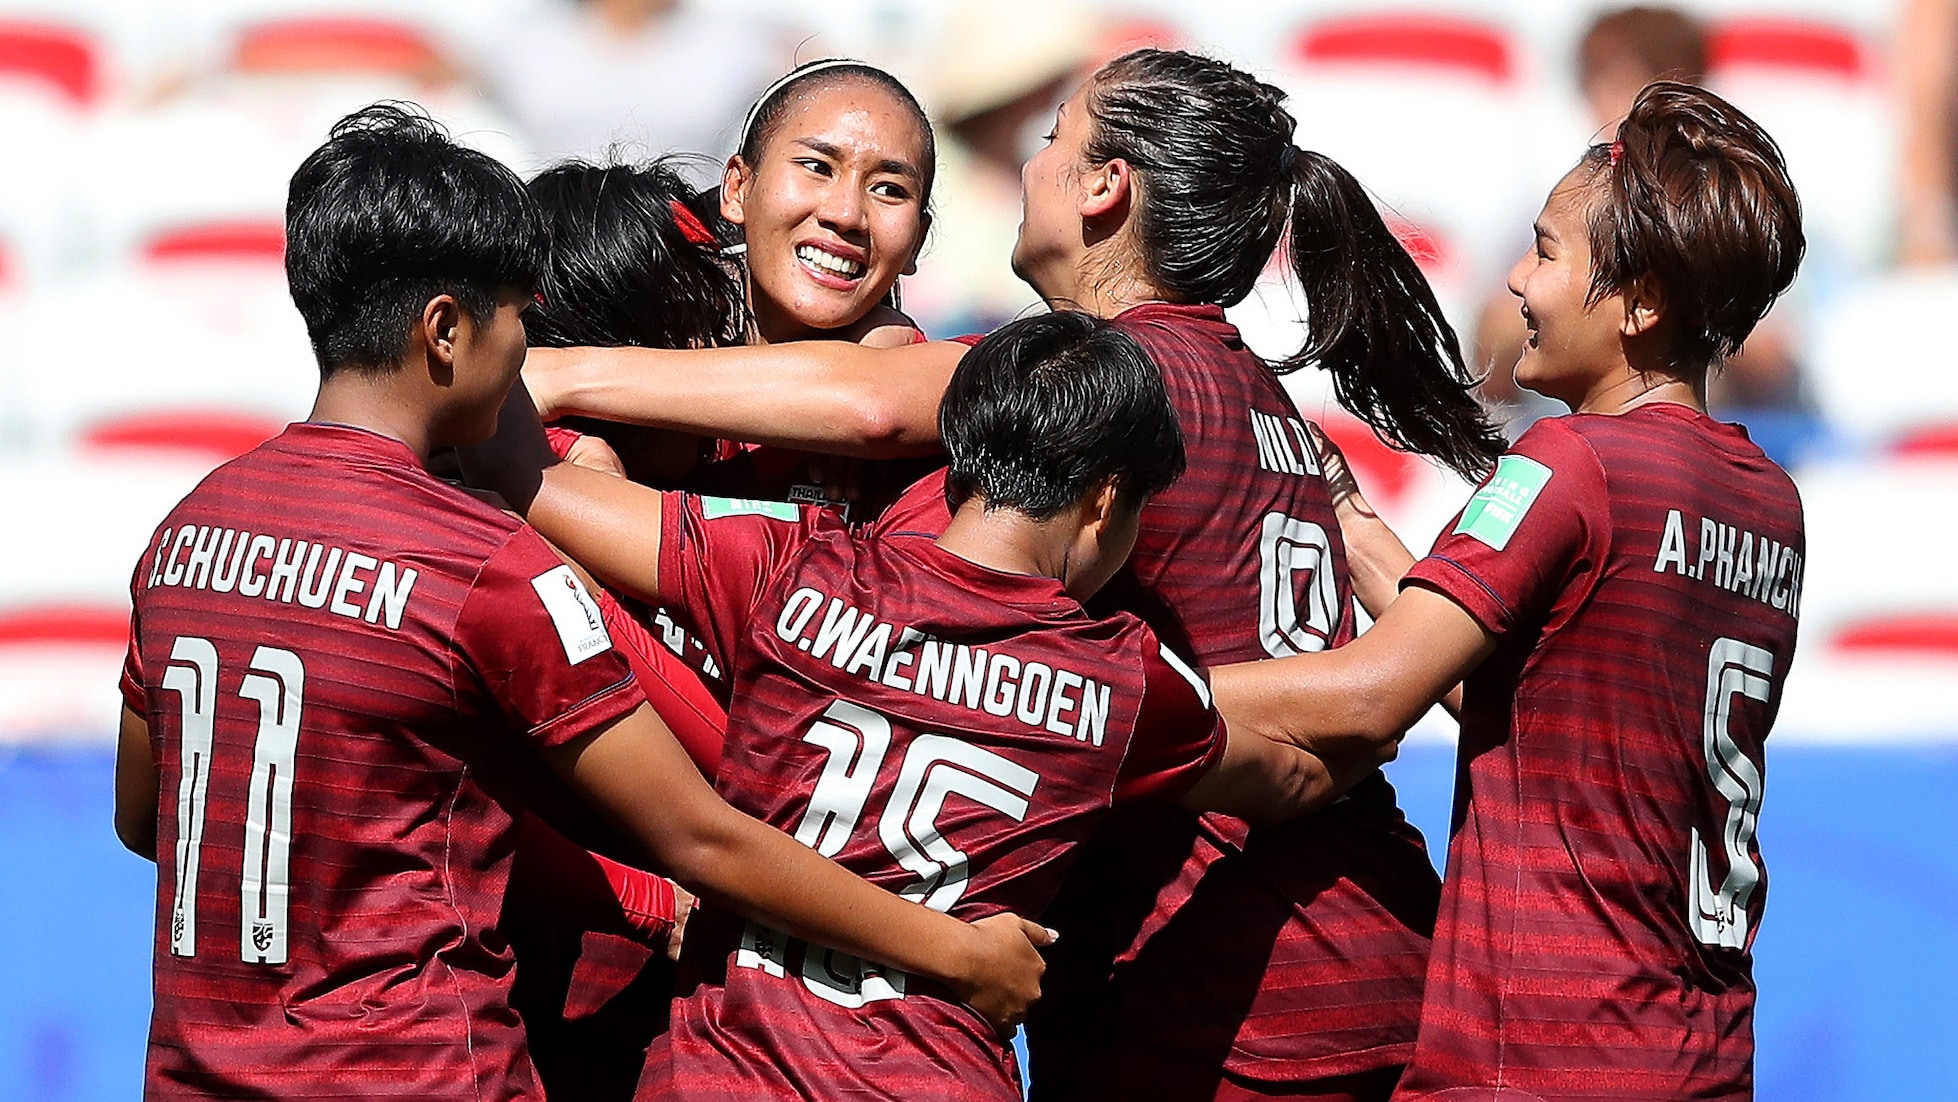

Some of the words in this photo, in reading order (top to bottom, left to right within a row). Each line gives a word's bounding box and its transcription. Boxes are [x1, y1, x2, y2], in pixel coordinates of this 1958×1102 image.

[1250, 408, 1320, 475] NILD
[776, 587, 1110, 746] O.WAENNGOEN
[163, 636, 305, 963] 11
[1689, 637, 1773, 948] 5
